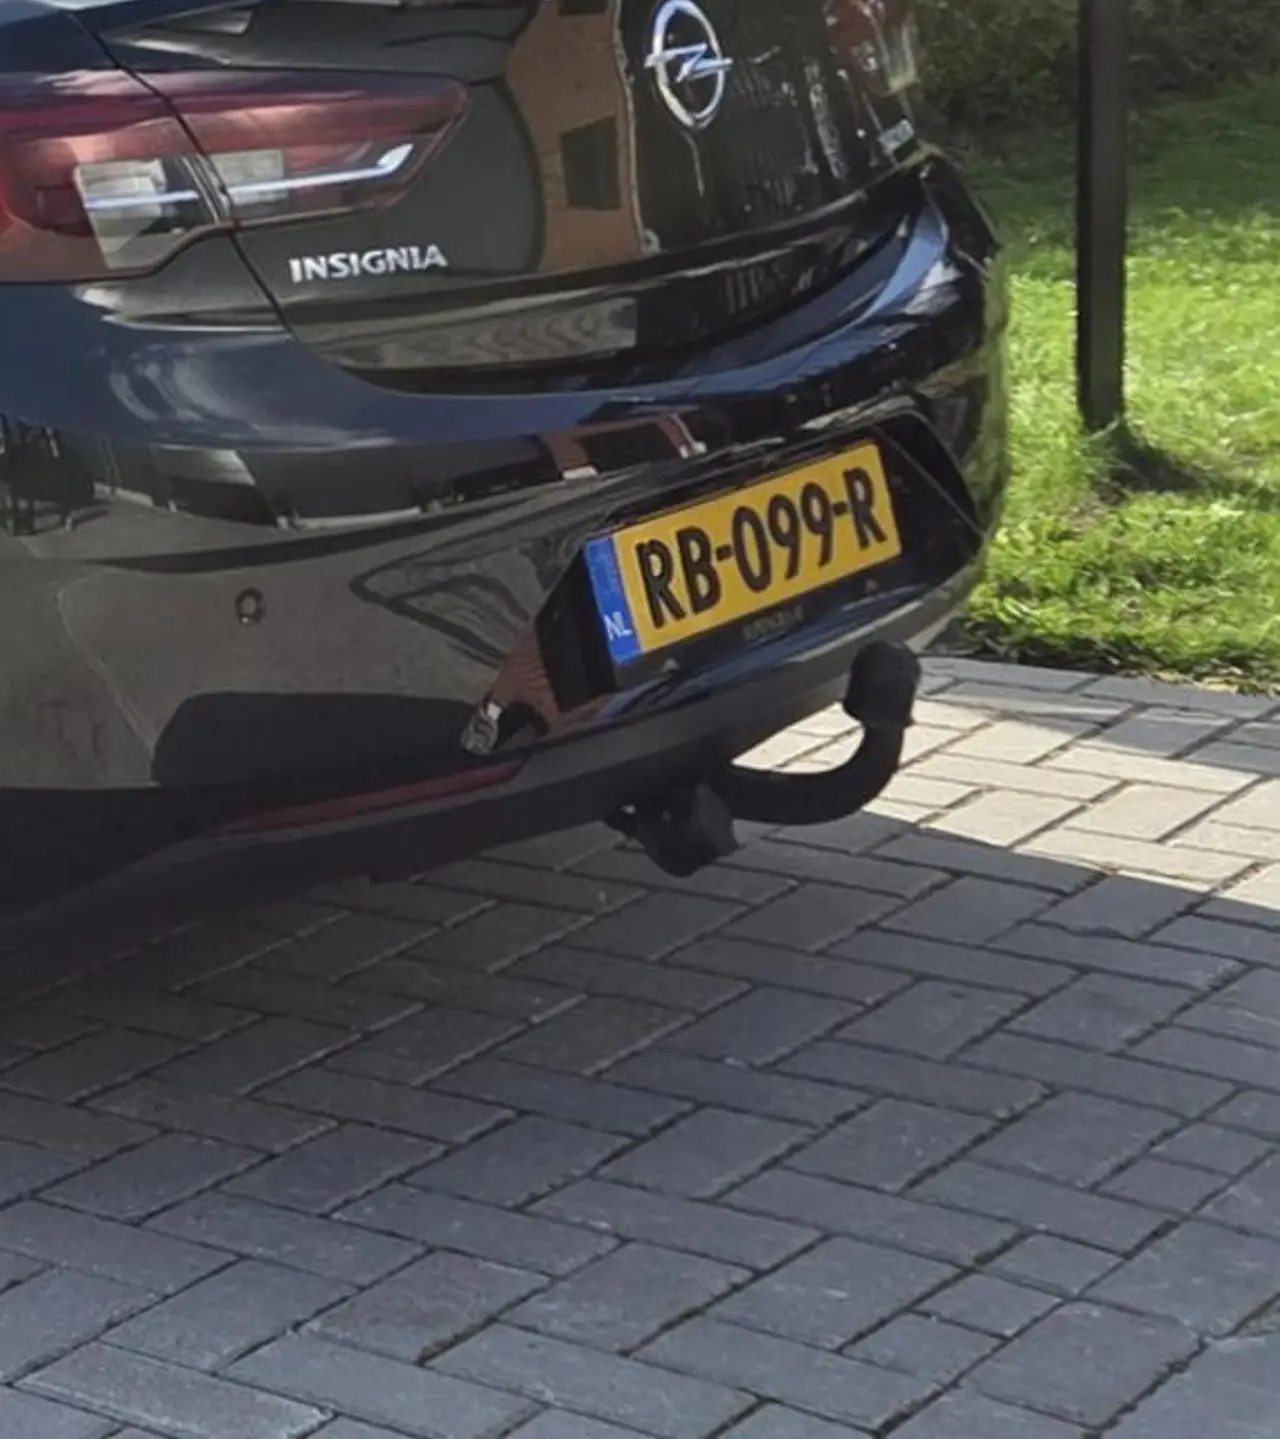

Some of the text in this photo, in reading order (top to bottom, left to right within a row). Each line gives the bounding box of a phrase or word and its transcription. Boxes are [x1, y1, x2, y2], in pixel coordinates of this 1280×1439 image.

[289, 244, 449, 283] INSIGNIA
[635, 466, 887, 629] RB-099-R
[603, 611, 633, 641] NL
